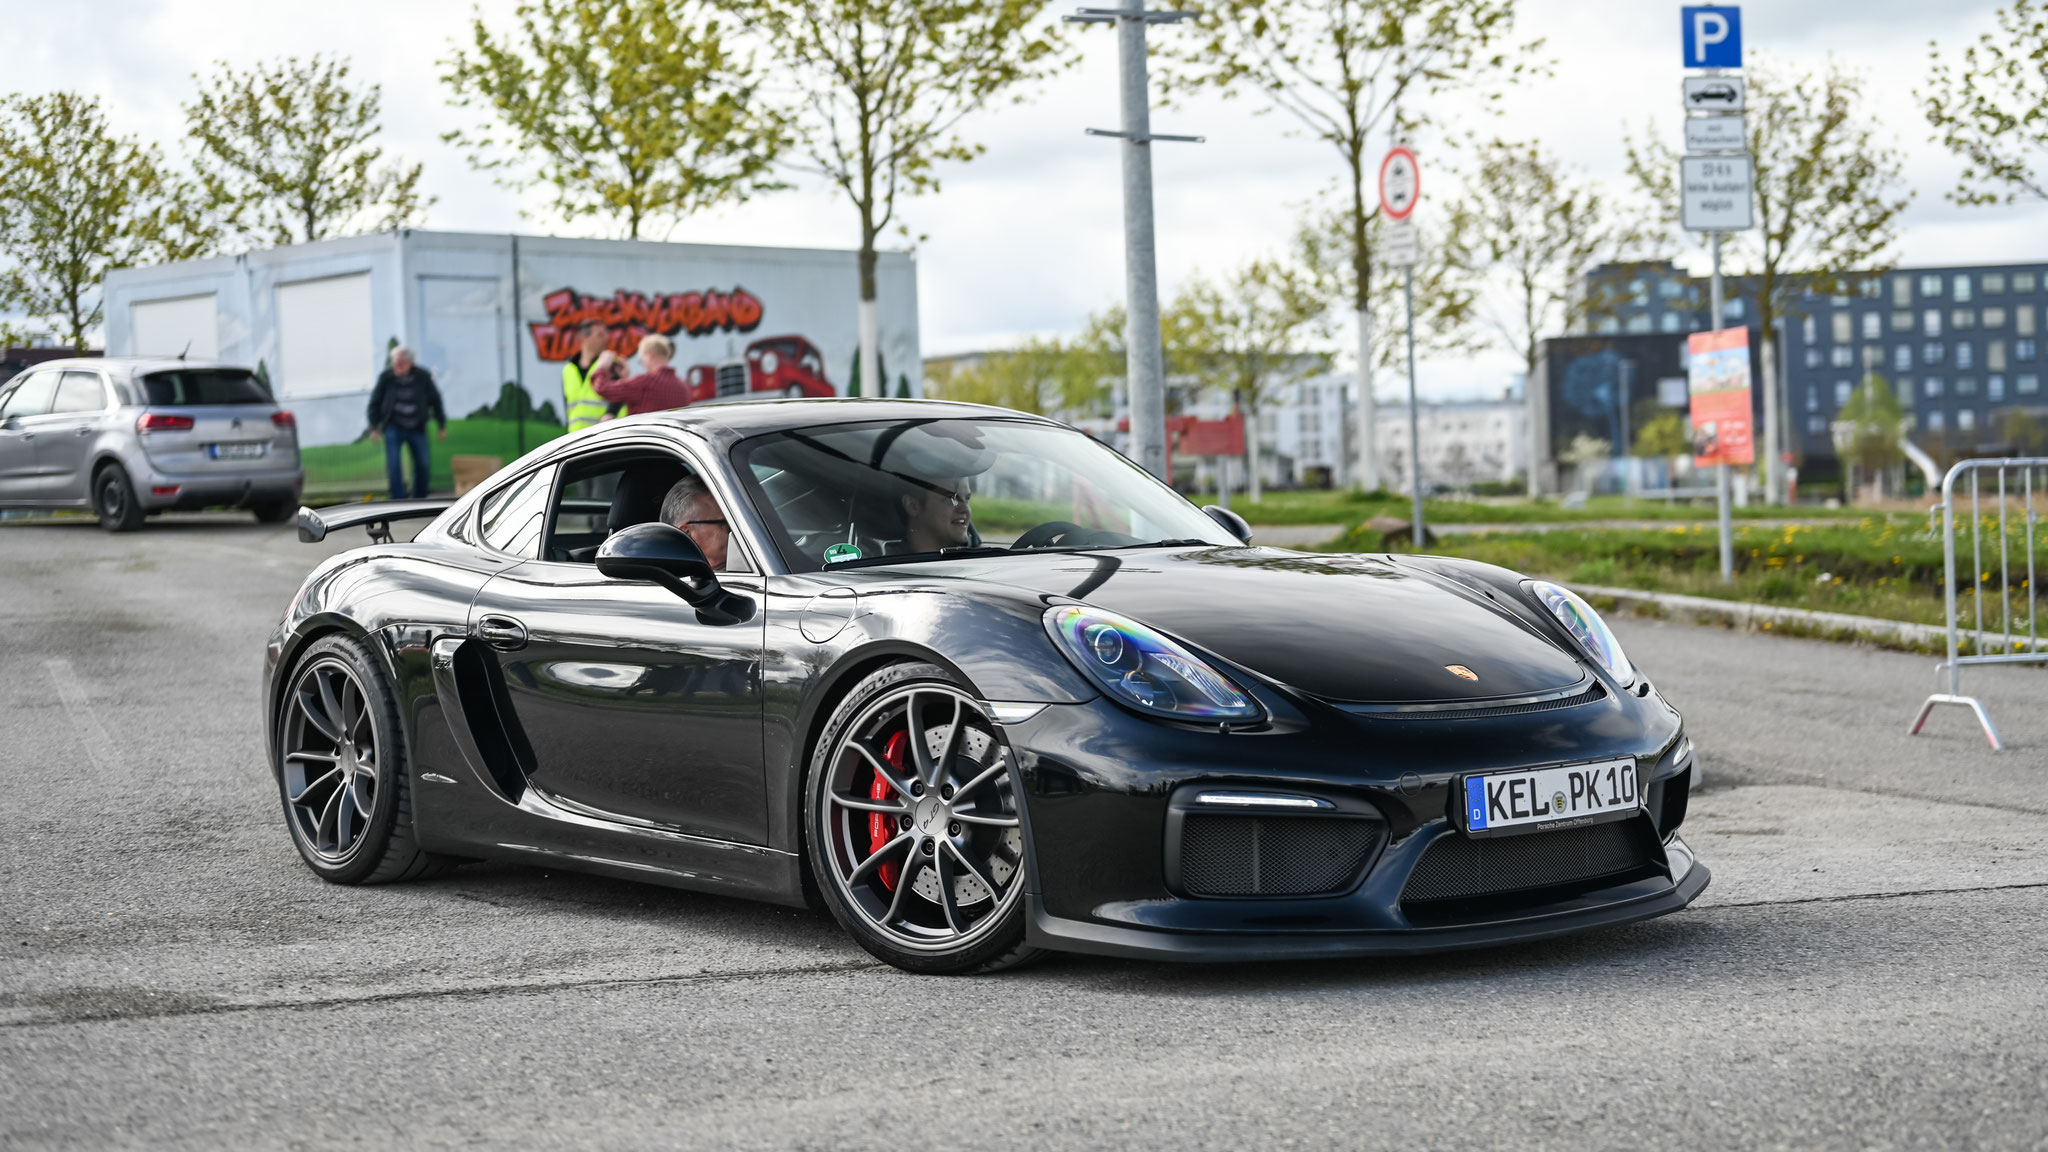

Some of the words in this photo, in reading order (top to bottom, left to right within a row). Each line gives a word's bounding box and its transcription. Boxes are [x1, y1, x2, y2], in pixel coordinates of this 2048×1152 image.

[1694, 12, 1729, 63] P
[837, 545, 847, 554] 4
[1487, 777, 1550, 822] KEL
[1568, 769, 1603, 811] PK
[1606, 765, 1635, 806] 10
[873, 783, 882, 837] PORHE
[1473, 808, 1481, 821] D
[1536, 823, 1555, 831] Porsche
[1555, 820, 1573, 828] Zentrum
[1573, 817, 1594, 826] Offenburg
